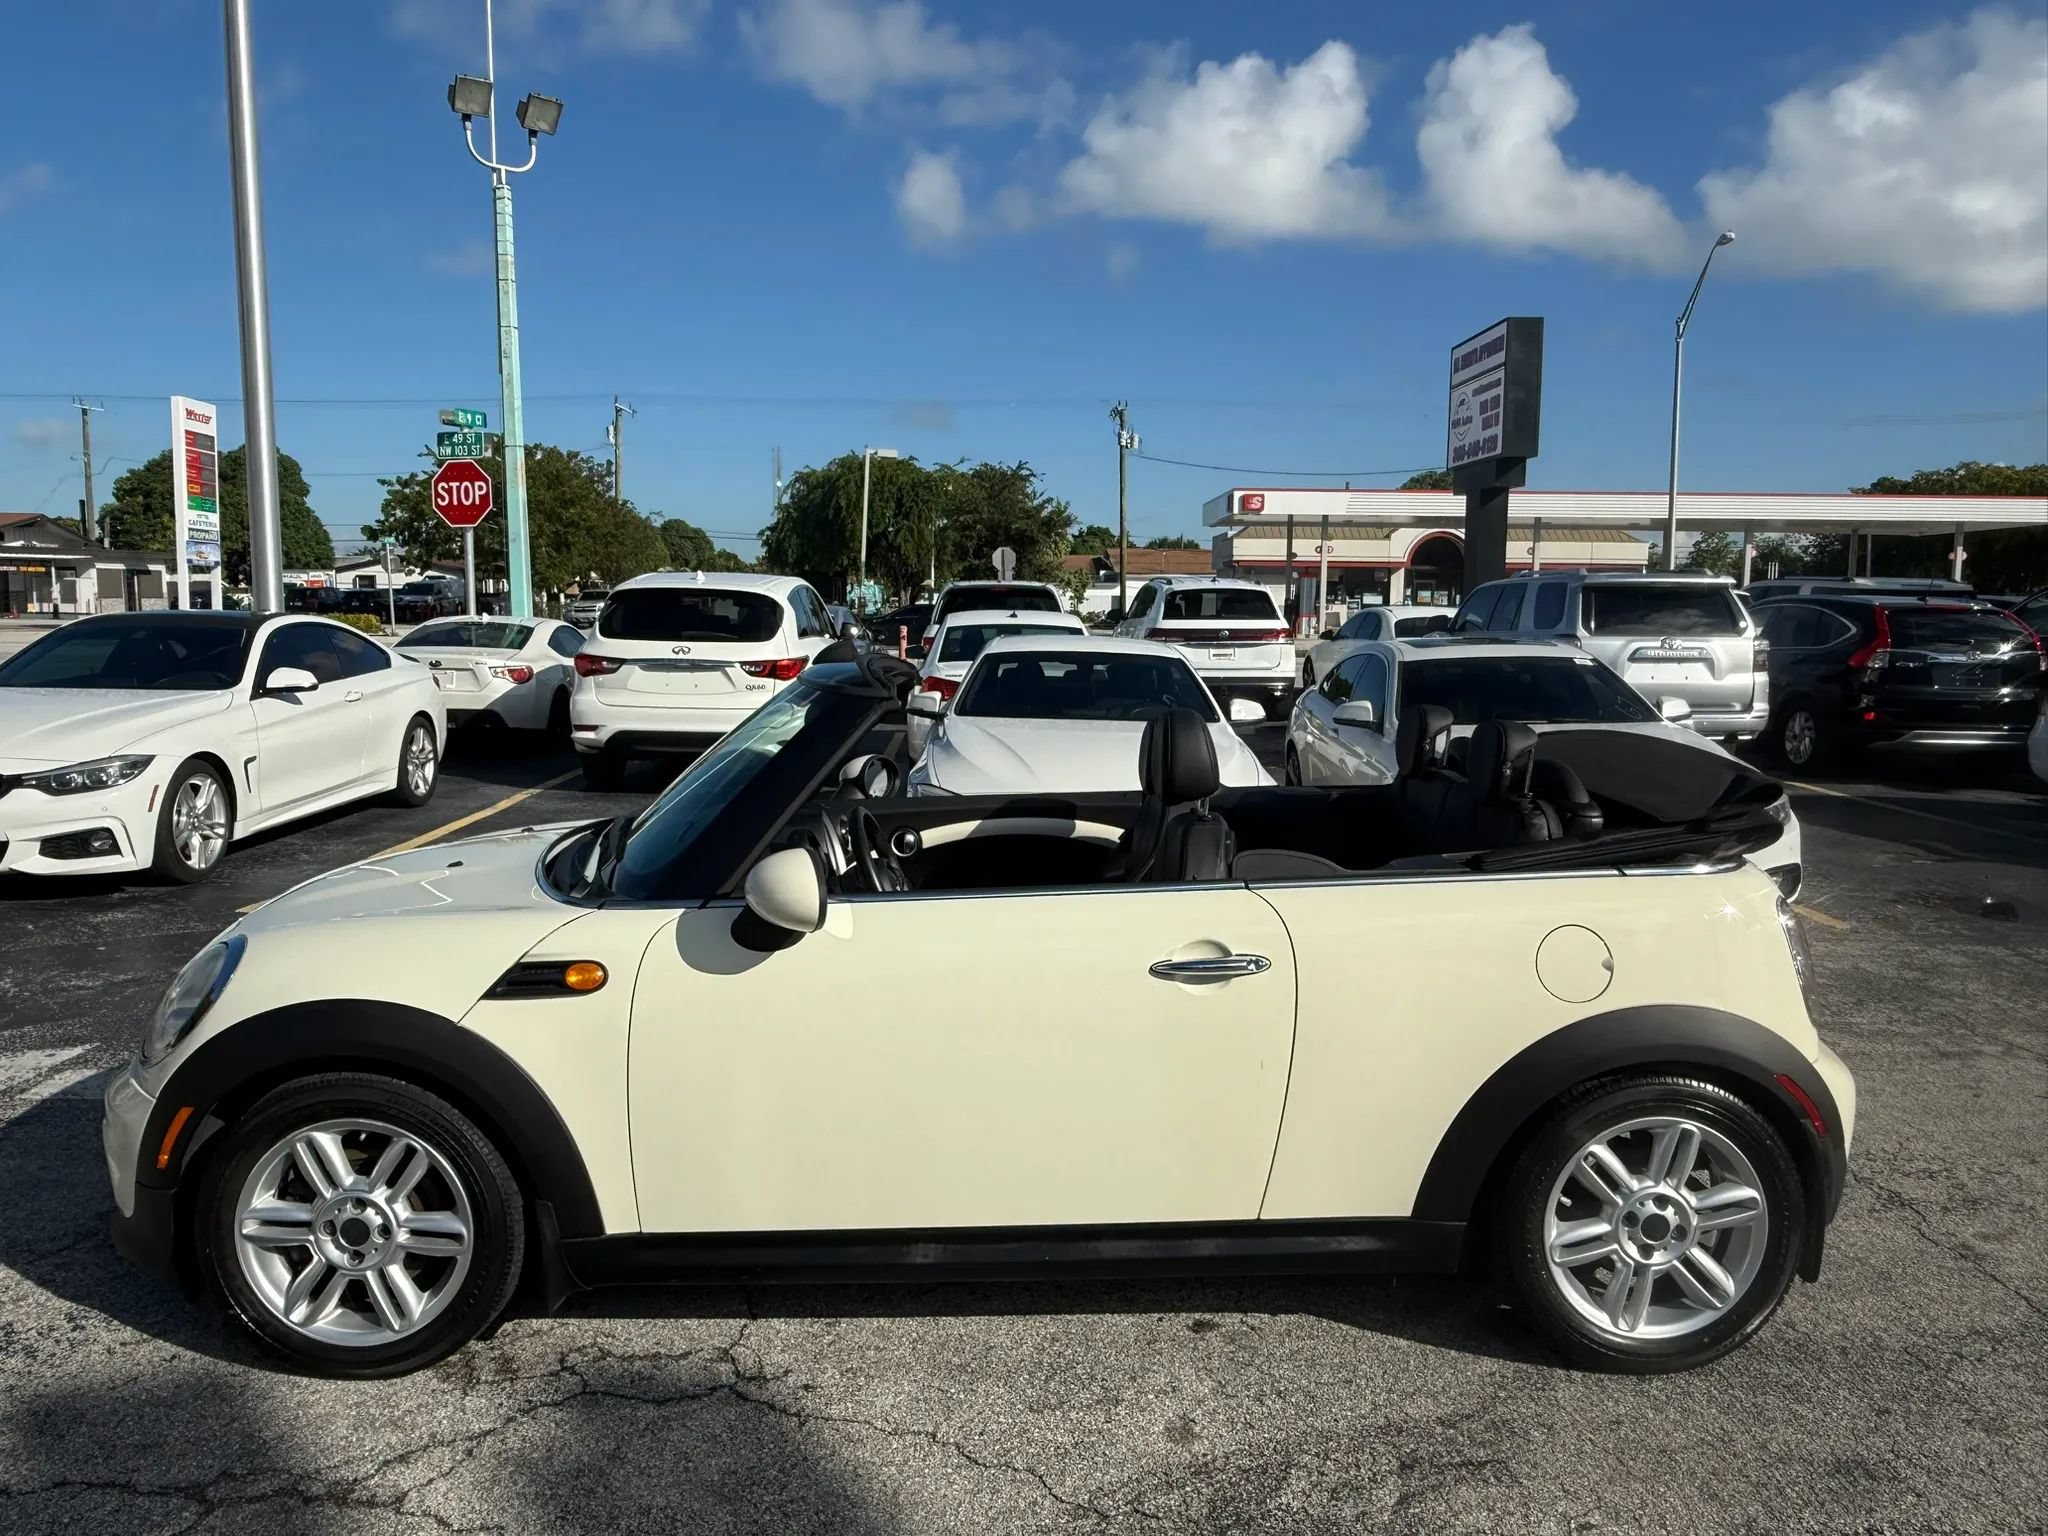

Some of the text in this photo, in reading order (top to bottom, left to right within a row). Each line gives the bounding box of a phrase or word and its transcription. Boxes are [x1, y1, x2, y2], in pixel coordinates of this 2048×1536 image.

[452, 433, 463, 444] 49
[466, 433, 476, 444] ST
[439, 445, 481, 456] NW 103 ST
[437, 481, 487, 507] STOP
[188, 519, 218, 529] CAFETERIA
